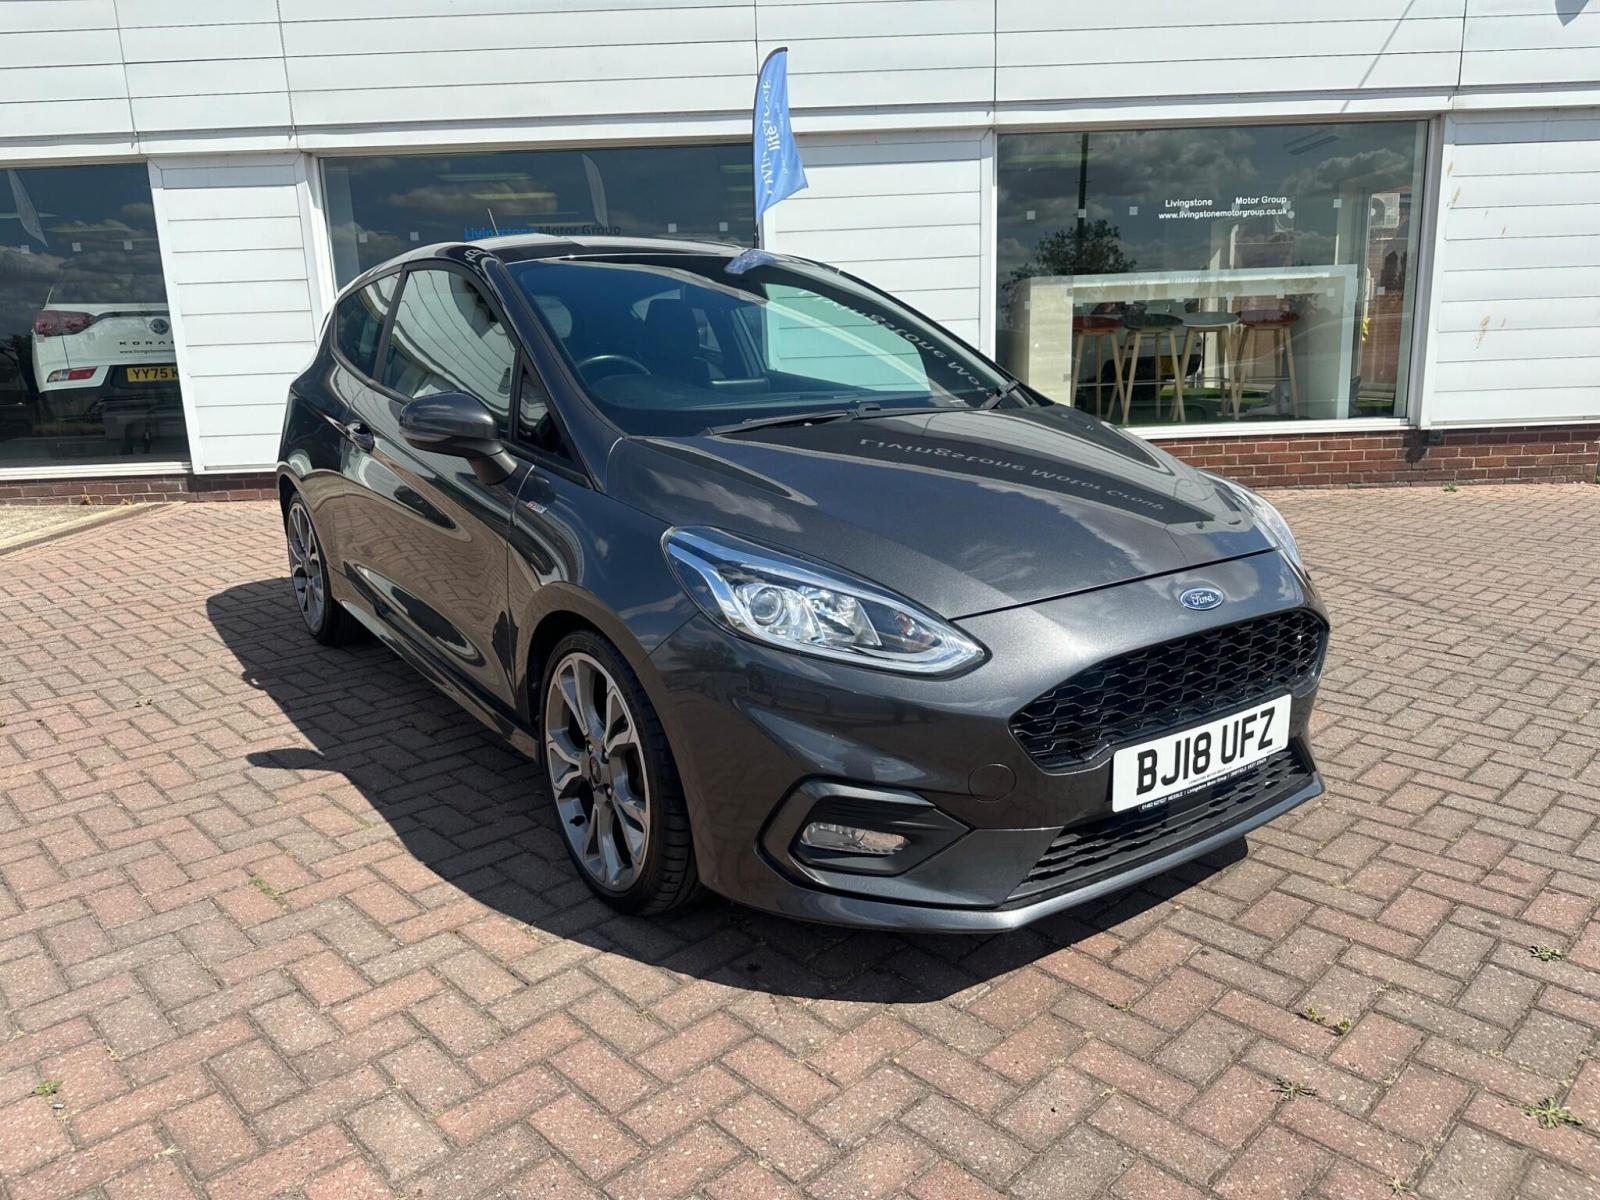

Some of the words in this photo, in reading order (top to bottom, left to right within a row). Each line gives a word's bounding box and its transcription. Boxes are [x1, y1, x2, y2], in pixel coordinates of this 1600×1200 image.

[1164, 199, 1213, 209] Livingstone
[1235, 197, 1259, 205] Motor
[1261, 196, 1287, 205] Group
[1158, 207, 1288, 220] www.livingstonemotorgroup.co.uk
[463, 224, 537, 241] Livinstone
[133, 368, 169, 380] YY75
[1190, 591, 1215, 606] Ford
[1136, 731, 1212, 796] BJ18
[1220, 706, 1276, 765] UFZ
